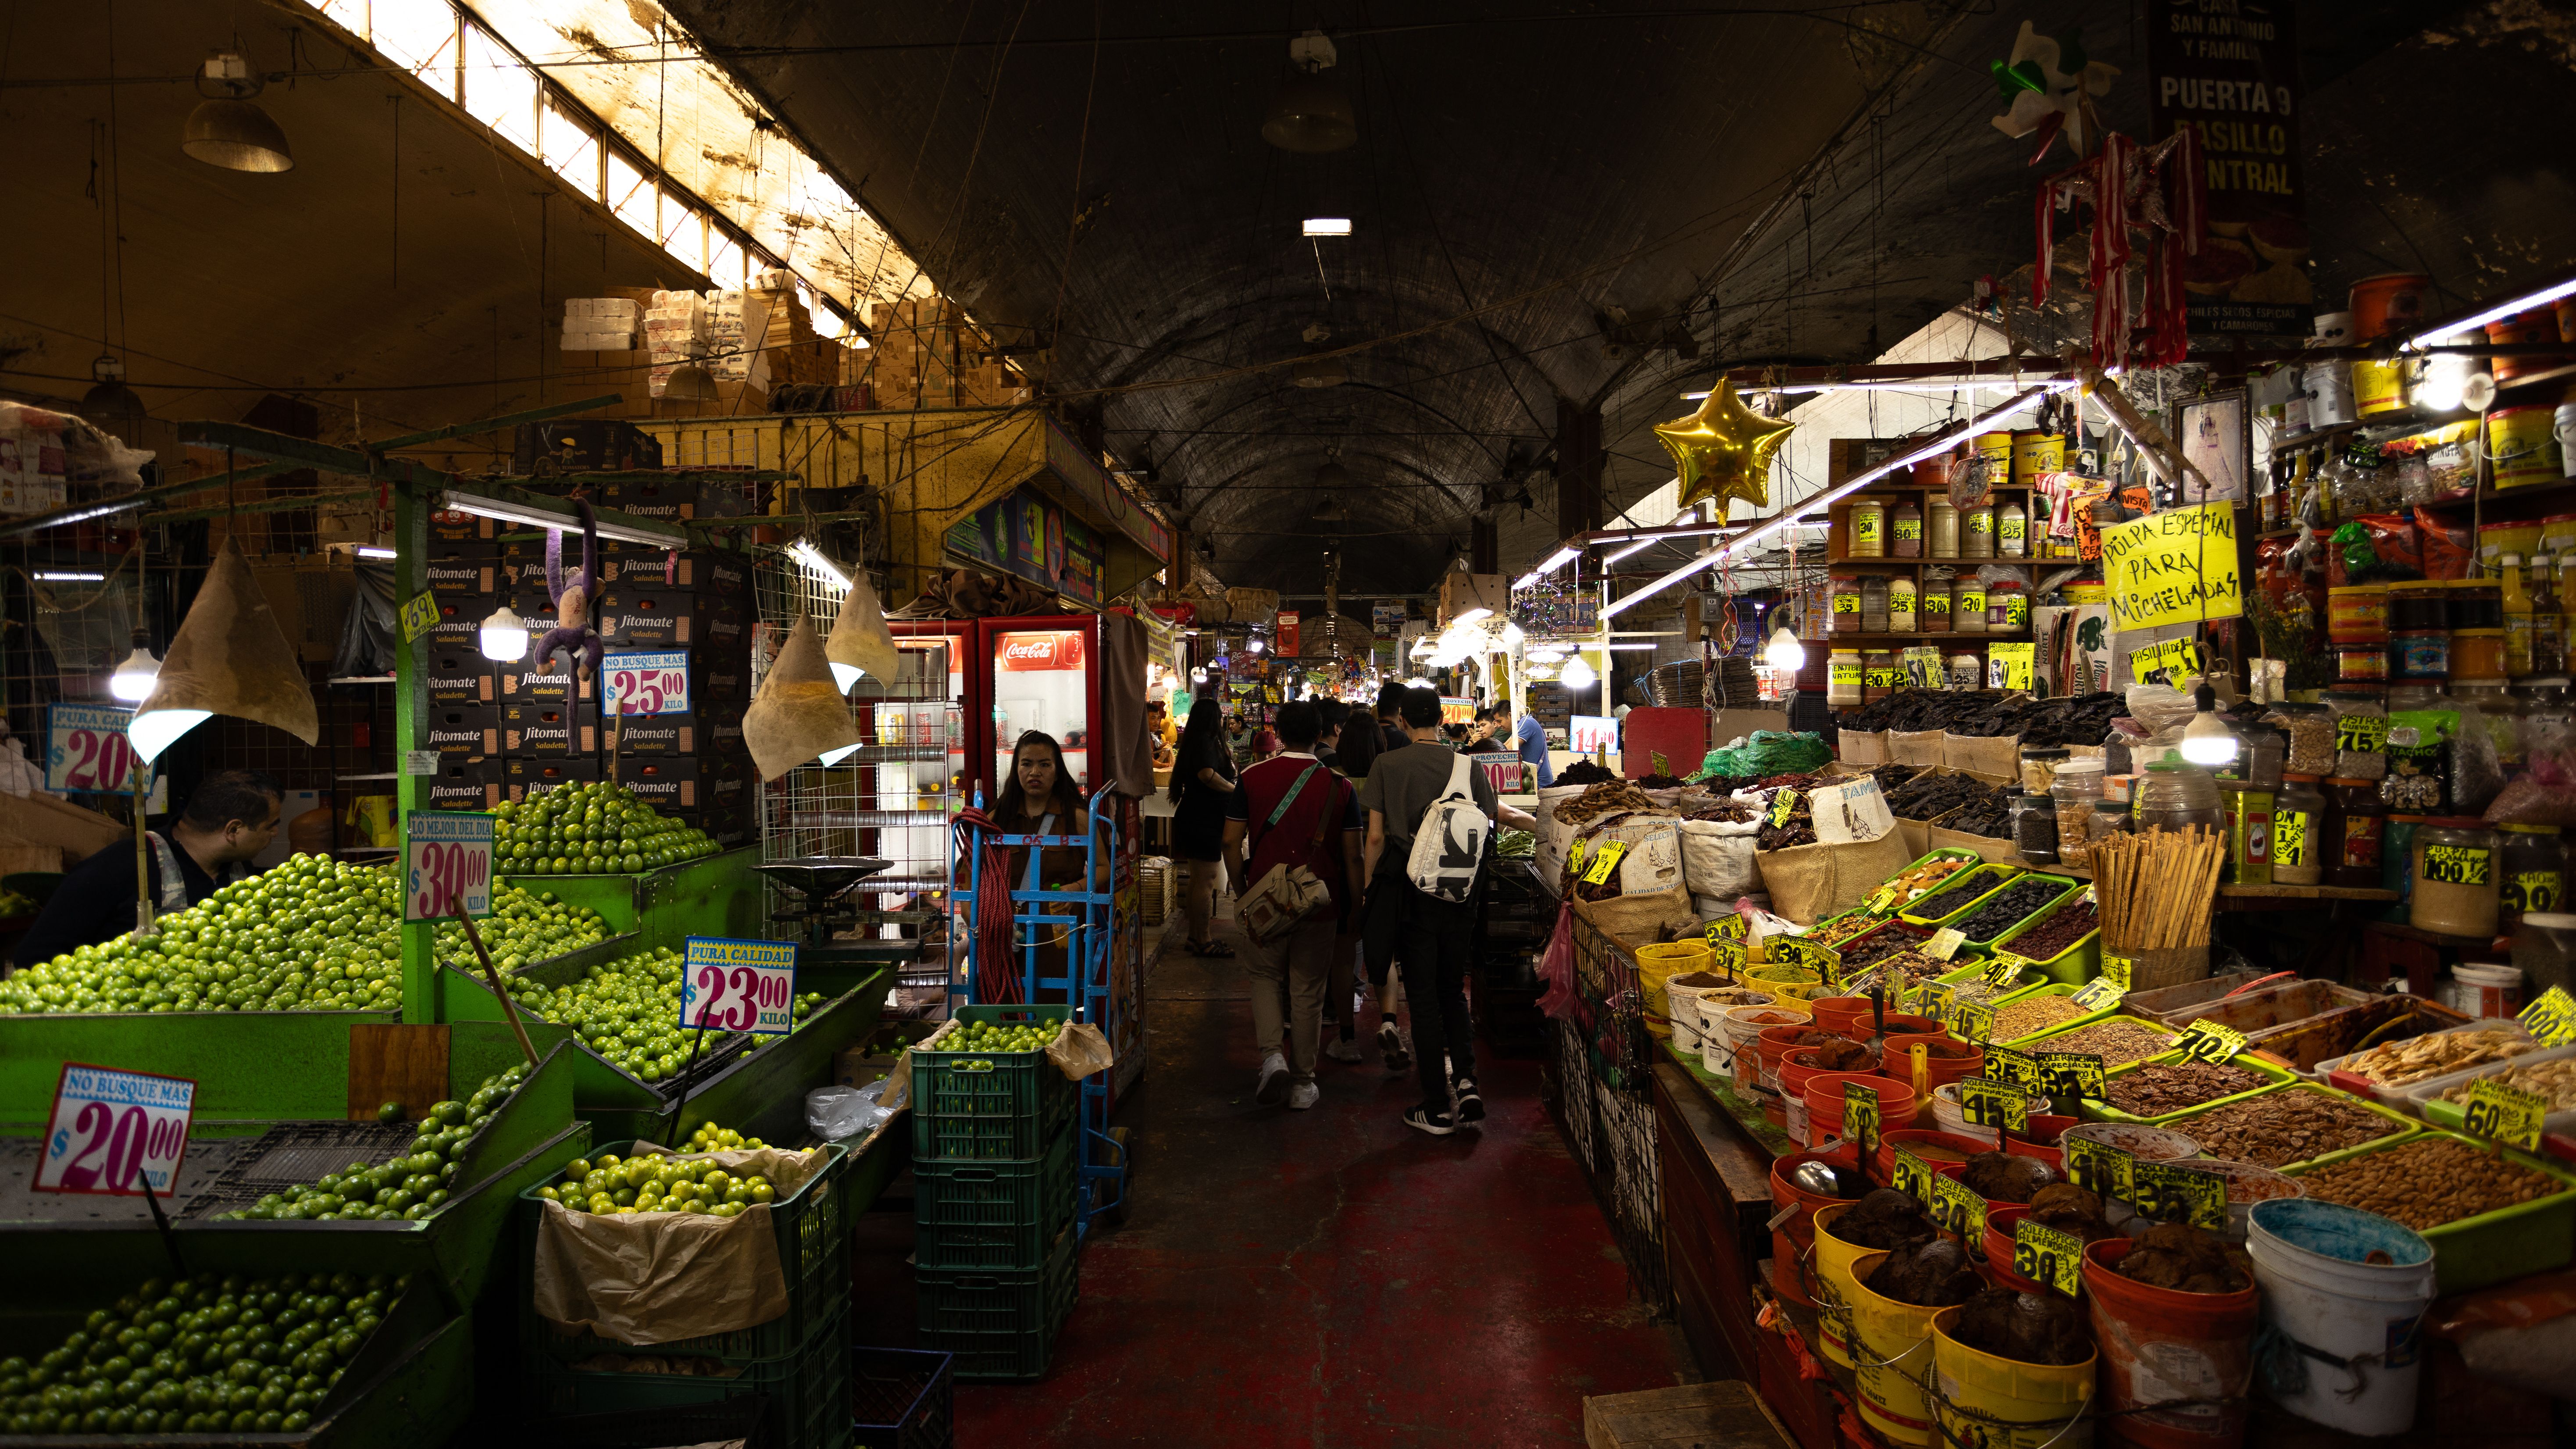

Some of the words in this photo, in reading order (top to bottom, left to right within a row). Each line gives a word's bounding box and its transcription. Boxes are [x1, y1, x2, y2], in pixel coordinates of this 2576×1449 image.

[2170, 14, 2203, 34] SAN
[2208, 16, 2275, 41] ANTONIO
[2181, 39, 2193, 57] Y
[2198, 39, 2262, 63] FAMILIA
[2160, 76, 2270, 113] PUERTA
[2275, 86, 2291, 117] 9
[2186, 307, 2219, 317] CHILES
[2256, 307, 2295, 319] ESPECIAS
[2212, 320, 2217, 330] Y
[2220, 321, 2274, 331] CAMARONES
[1970, 522, 1986, 534] 65
[427, 567, 477, 580] Jitomate
[712, 565, 742, 583] Jitomate
[1838, 603, 1853, 612] 35
[1891, 601, 1909, 612] 25
[1962, 597, 1980, 611] 30
[620, 615, 673, 628] Jitomate
[2007, 609, 2025, 625] 30
[709, 619, 741, 635] Jitomate
[1006, 642, 1052, 660] Coca-Cola
[606, 657, 619, 667] NO
[622, 656, 661, 668] BUSQUE
[664, 655, 684, 664] MAS
[708, 672, 737, 687] Jitomate
[1866, 675, 1883, 687] 30
[1906, 659, 1927, 688] 50
[1955, 675, 1970, 685] 25
[428, 677, 476, 689] Jitomate
[664, 700, 683, 709] KILO
[57, 710, 99, 724] PURA
[429, 730, 480, 744] Jitomate
[622, 727, 675, 742] Jitomate
[713, 724, 742, 740] Jitomate
[2337, 731, 2373, 752] 75
[430, 785, 482, 800] Jitomate
[714, 778, 742, 796] Jitomate
[412, 821, 425, 835] LO
[427, 821, 456, 835] MEJOR
[459, 821, 475, 835] DEL
[477, 821, 491, 835] DIA
[717, 829, 743, 844] Jitomate
[2426, 844, 2468, 857] PULPA
[2426, 860, 2463, 883] 100
[467, 896, 485, 910] KILO
[691, 946, 727, 959] PURA
[731, 949, 792, 963] CALIDAD
[1984, 963, 2008, 983] 40
[1916, 989, 1942, 1021] 45
[760, 1012, 788, 1025] KILO
[2514, 1002, 2559, 1038] 100
[2173, 1028, 2222, 1057] 70
[67, 1074, 92, 1091] NO
[96, 1077, 157, 1098] BUSQUE
[160, 1085, 190, 1103] MAS
[2464, 1100, 2499, 1136] 60
[2018, 1221, 2041, 1235] MOLE
[2042, 1228, 2082, 1250] ESPECIAL
[2018, 1231, 2079, 1258] ALMENDRADO
